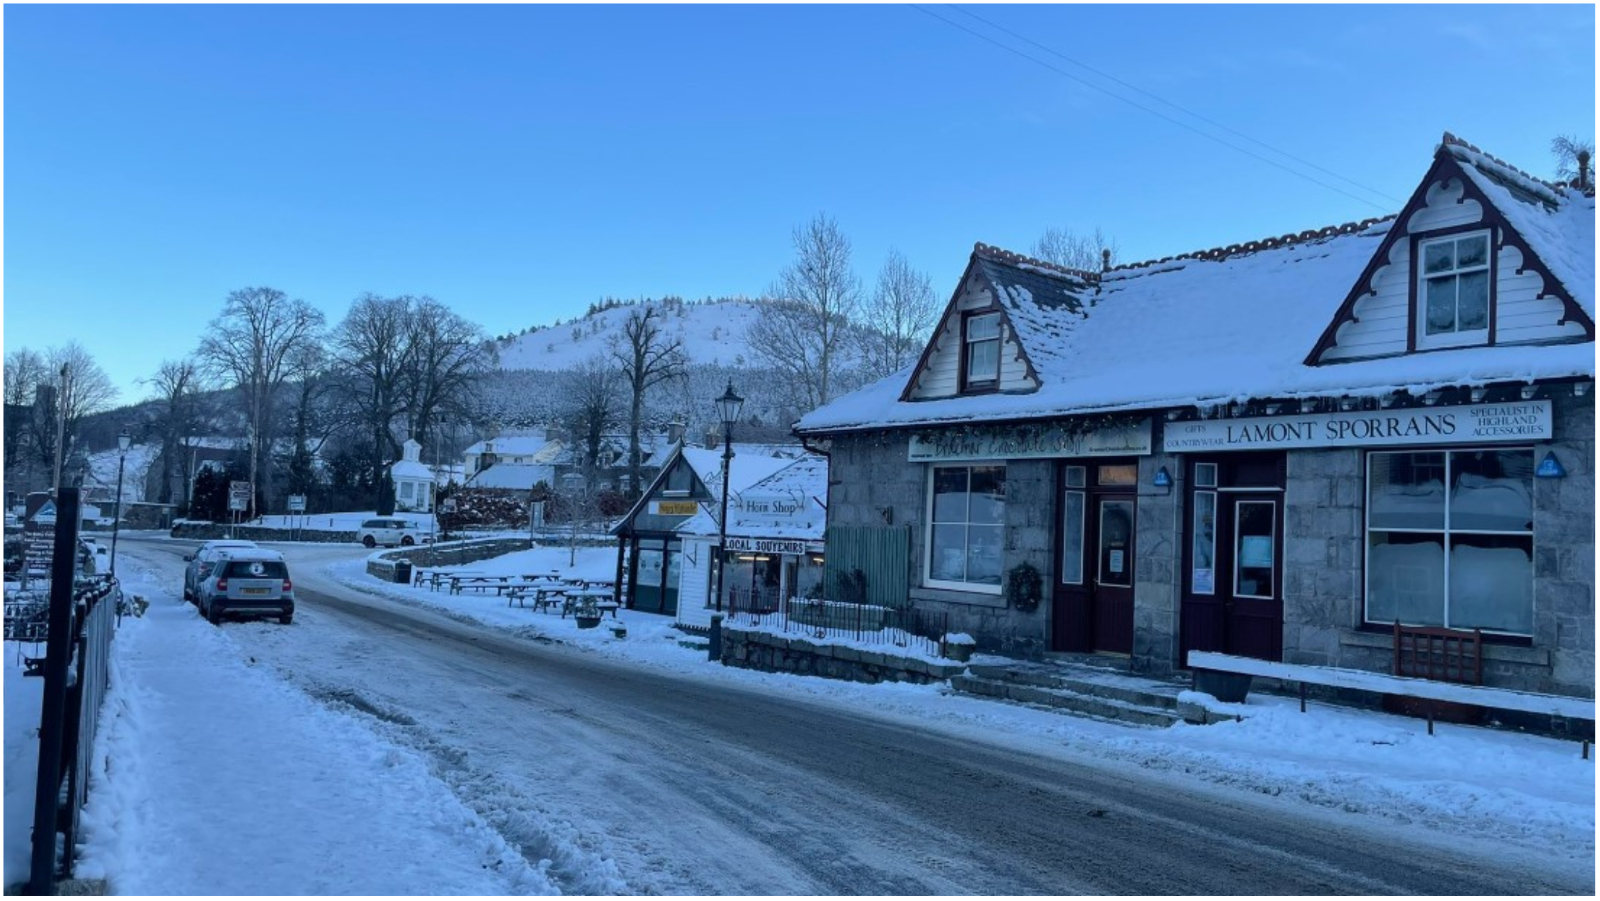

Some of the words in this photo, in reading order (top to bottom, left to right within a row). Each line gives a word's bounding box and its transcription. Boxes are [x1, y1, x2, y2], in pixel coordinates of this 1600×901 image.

[1470, 407, 1527, 417] SPECIALIST
[1531, 405, 1544, 414] IN
[1478, 416, 1537, 426] HIGHLAND
[1184, 424, 1207, 433] GIFTS
[1228, 422, 1317, 443] LAMONT
[1326, 414, 1456, 440] SPORRANS
[1471, 426, 1544, 437] ACCESSORIES
[1166, 438, 1225, 447] COUNTRYWEAR
[773, 500, 796, 516] Shop
[725, 539, 752, 551] LOCAL
[756, 541, 803, 554] SOUVENIRS
